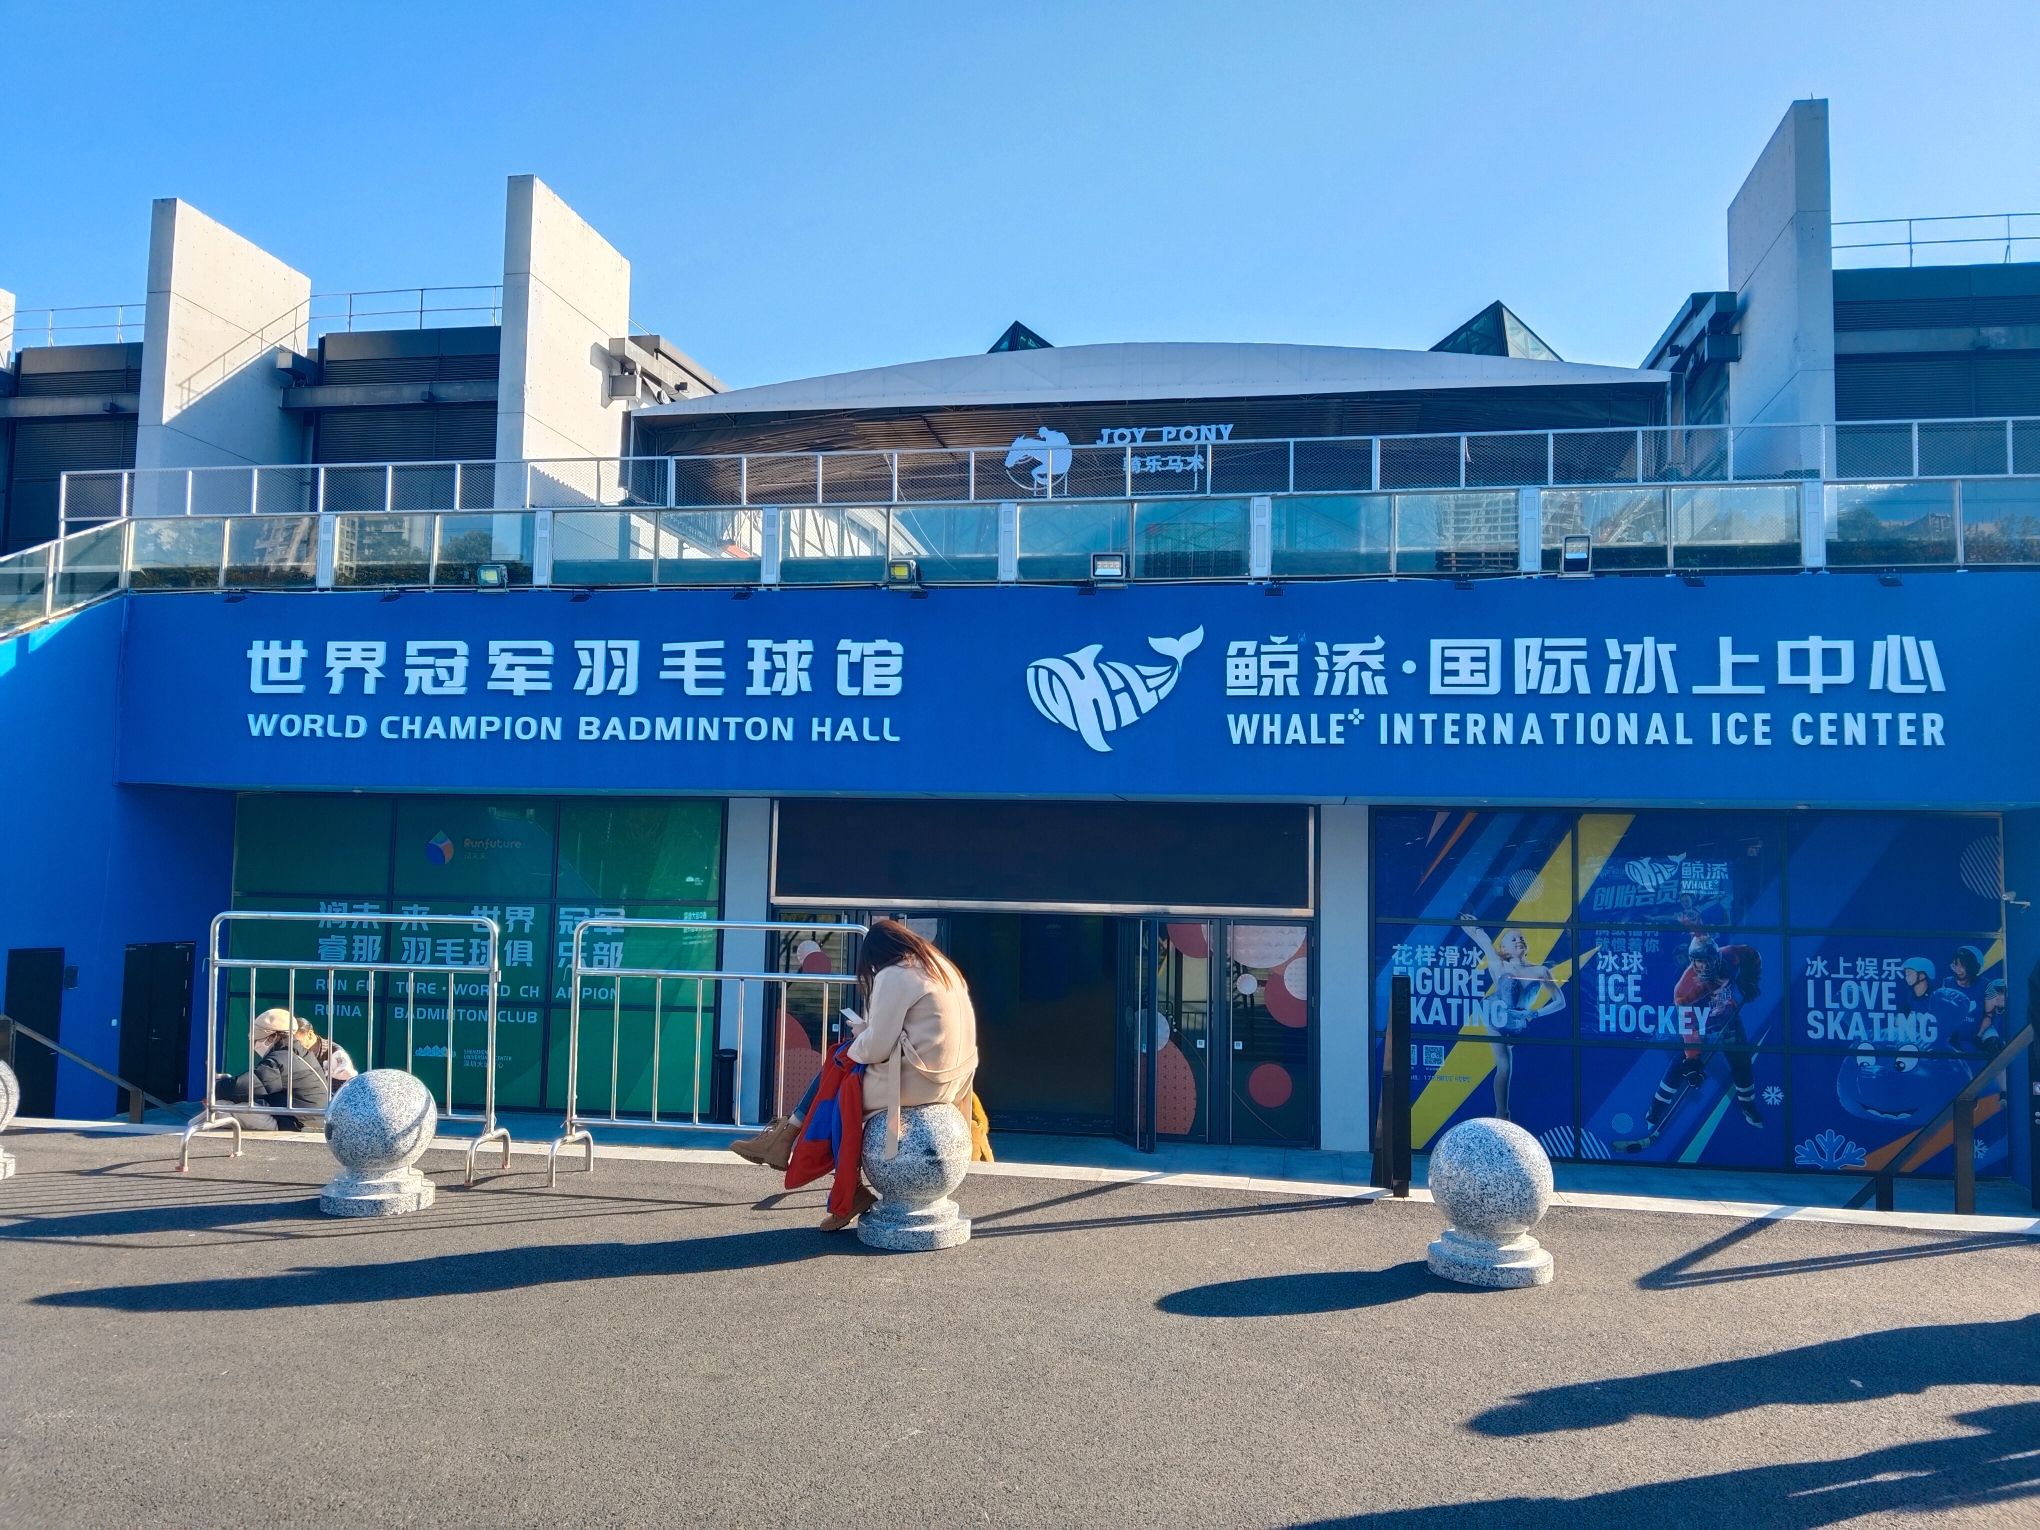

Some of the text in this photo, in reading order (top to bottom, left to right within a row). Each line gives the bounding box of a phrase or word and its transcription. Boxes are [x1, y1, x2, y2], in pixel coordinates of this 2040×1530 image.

[1096, 424, 1234, 446] JOY PONY
[247, 639, 904, 697] 世界冠军羽毛球馆
[247, 713, 901, 742] WORLD CHAMPION BADMINTON HALL
[1227, 712, 1946, 746] WHALE INTERNATIONAL ICE CENTER
[1681, 861, 1729, 880] 鲸添
[1682, 880, 1715, 890] WHALE
[318, 902, 626, 936] 润未来世界冠军
[1392, 943, 1487, 968] 花样滑冰
[1596, 951, 1645, 973] 冰球
[1805, 956, 1905, 980] 冰上娱乐
[454, 983, 511, 997] WORD
[1597, 973, 1643, 1003] ICE
[1807, 979, 1897, 1011] I LOVE
[497, 1010, 538, 1024] CLUB
[1409, 997, 1508, 1028] KATING
[1599, 1003, 1712, 1036] HOCKEY
[1806, 1010, 1938, 1043] SKATING
